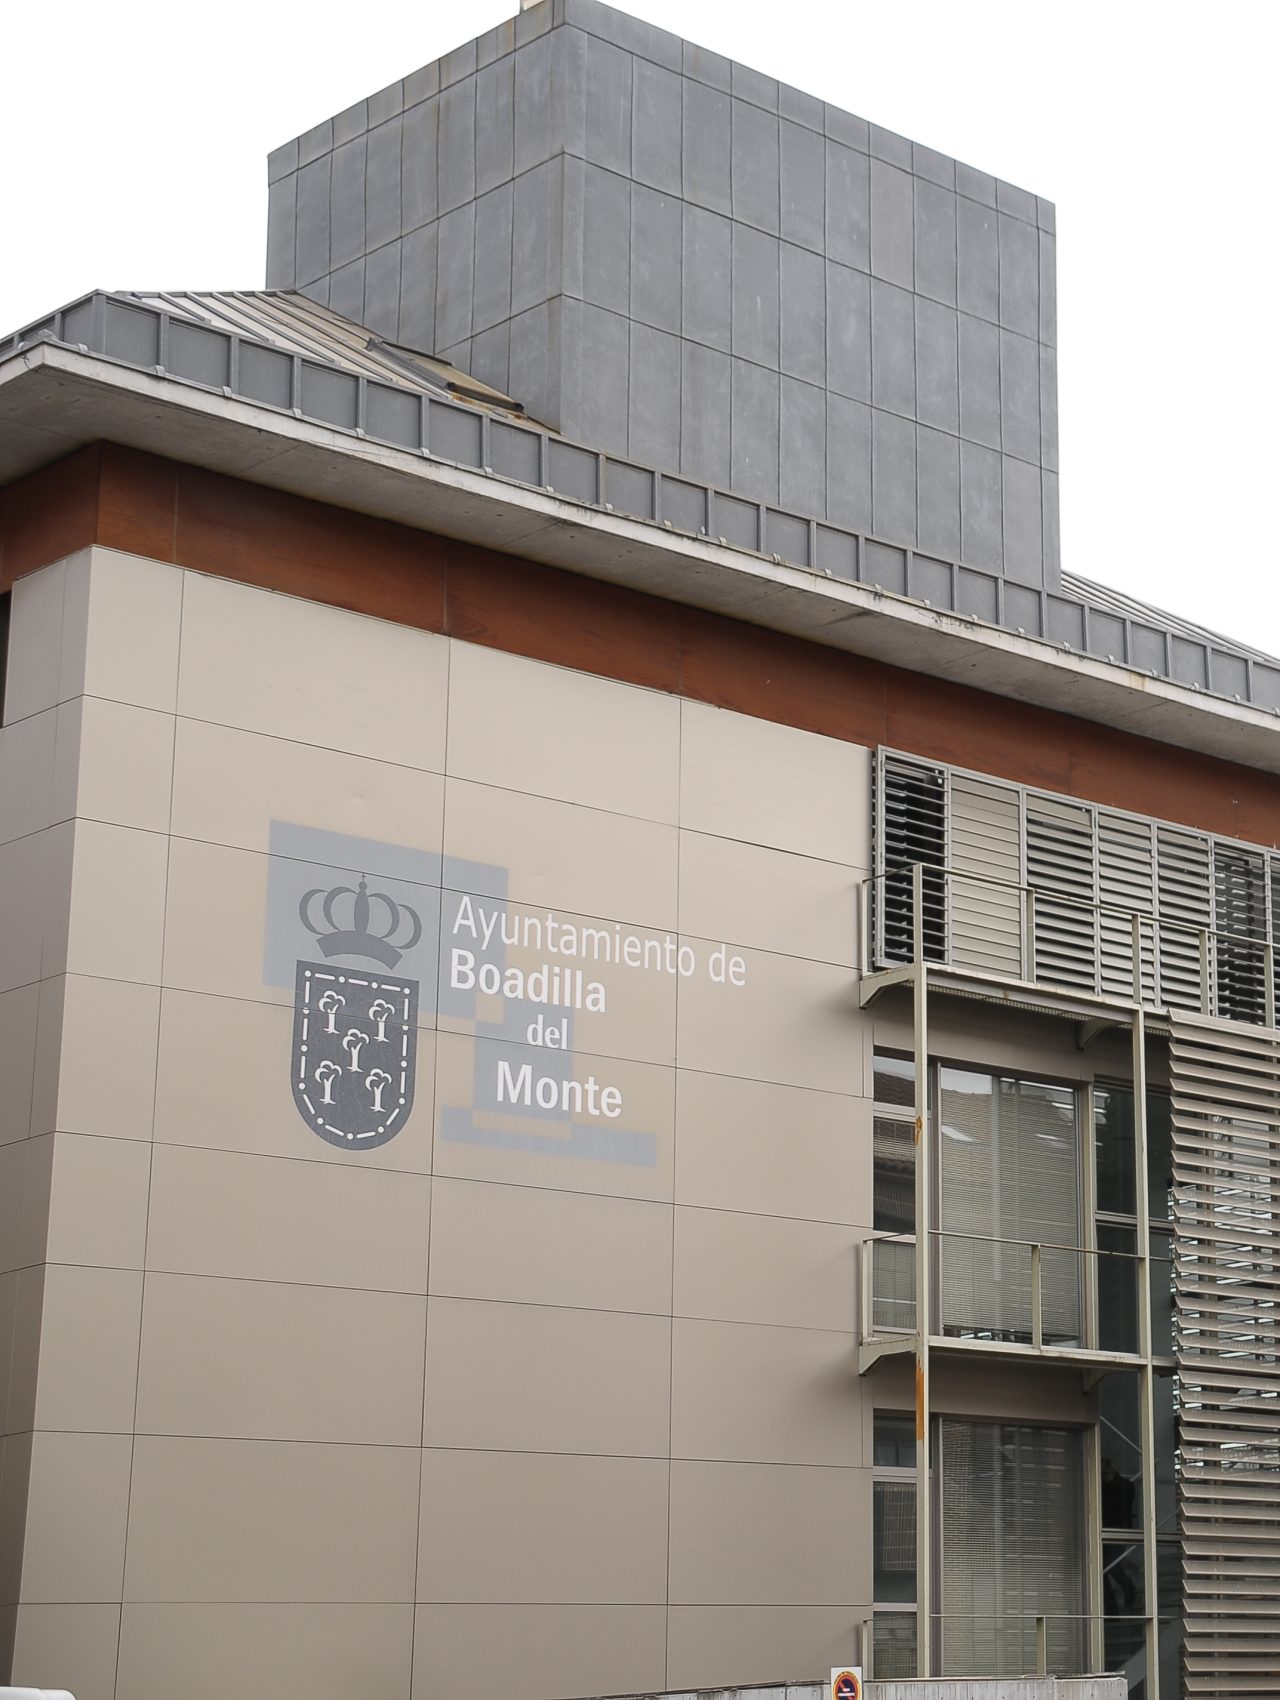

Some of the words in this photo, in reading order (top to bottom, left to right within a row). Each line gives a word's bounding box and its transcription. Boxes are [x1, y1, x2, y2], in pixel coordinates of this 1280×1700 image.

[452, 895, 696, 977] Ayuntamiento
[709, 944, 747, 986] de
[450, 948, 607, 1013] Boadilla
[526, 1014, 569, 1050] del
[496, 1060, 623, 1118] Monte
